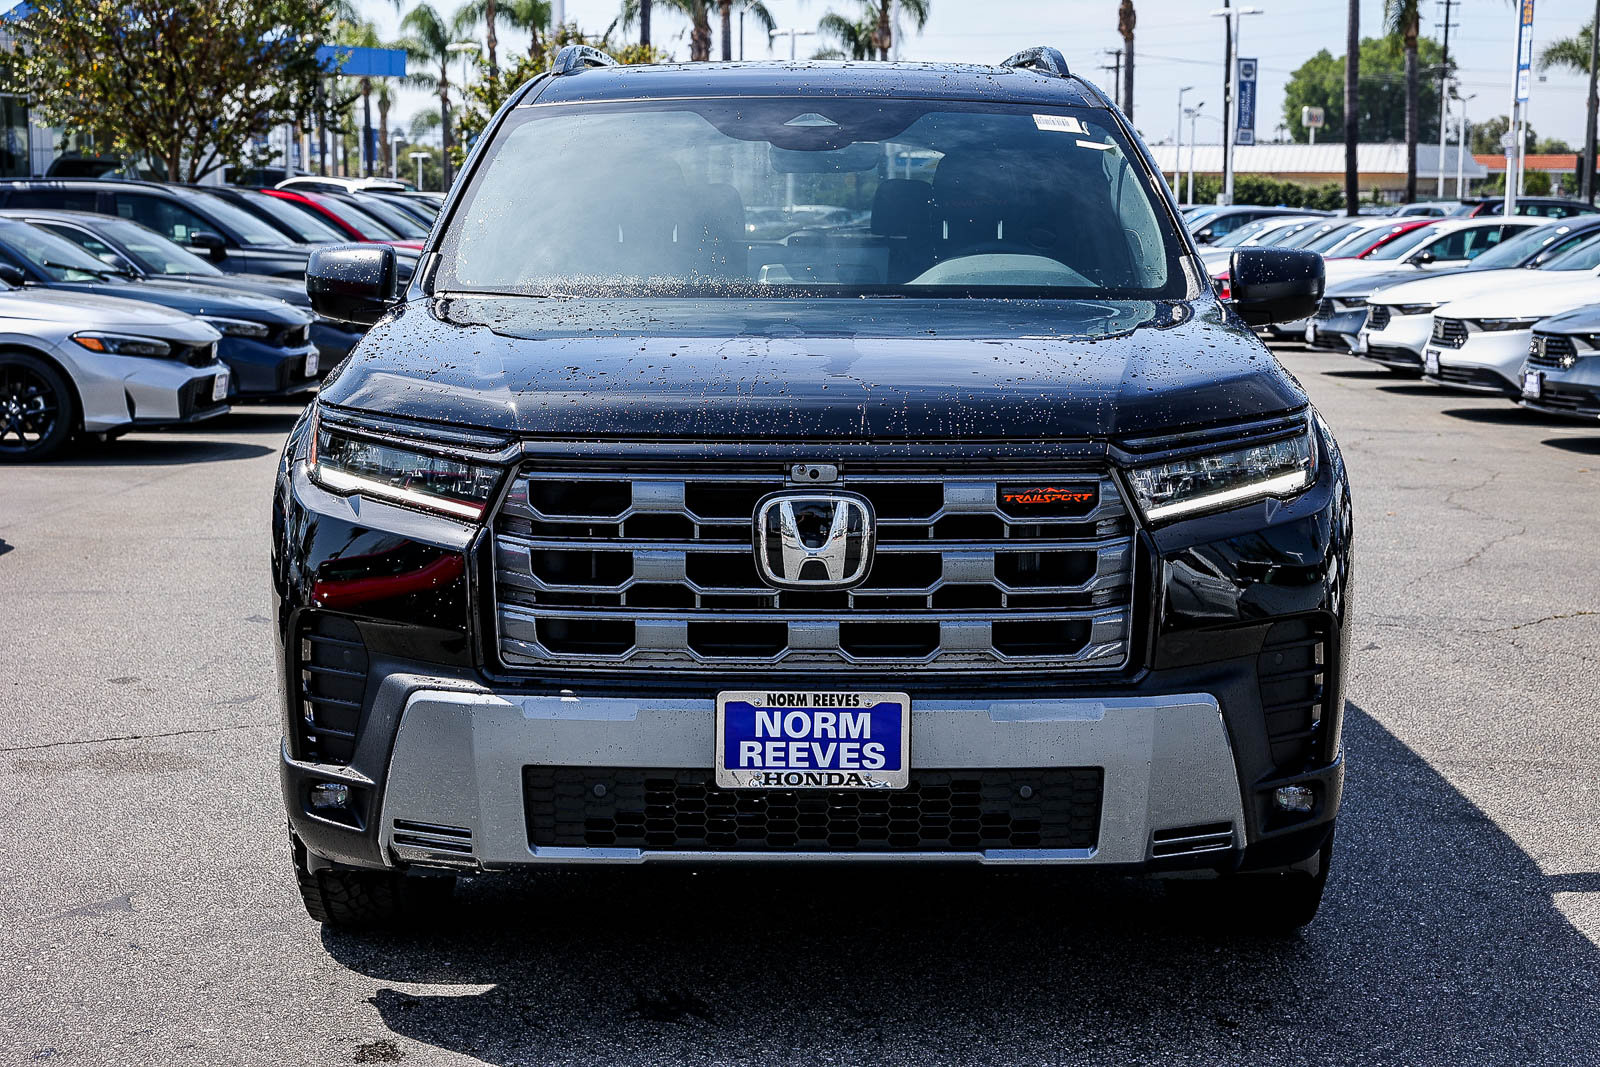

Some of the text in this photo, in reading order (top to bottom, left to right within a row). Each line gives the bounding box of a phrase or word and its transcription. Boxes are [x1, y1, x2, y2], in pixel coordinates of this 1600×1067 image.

[1003, 493, 1093, 504] TRAILSPORT
[766, 693, 860, 707] NORM REEVES
[755, 711, 871, 739] NORM
[739, 741, 886, 769] REEVES
[762, 772, 866, 787] HONDA
